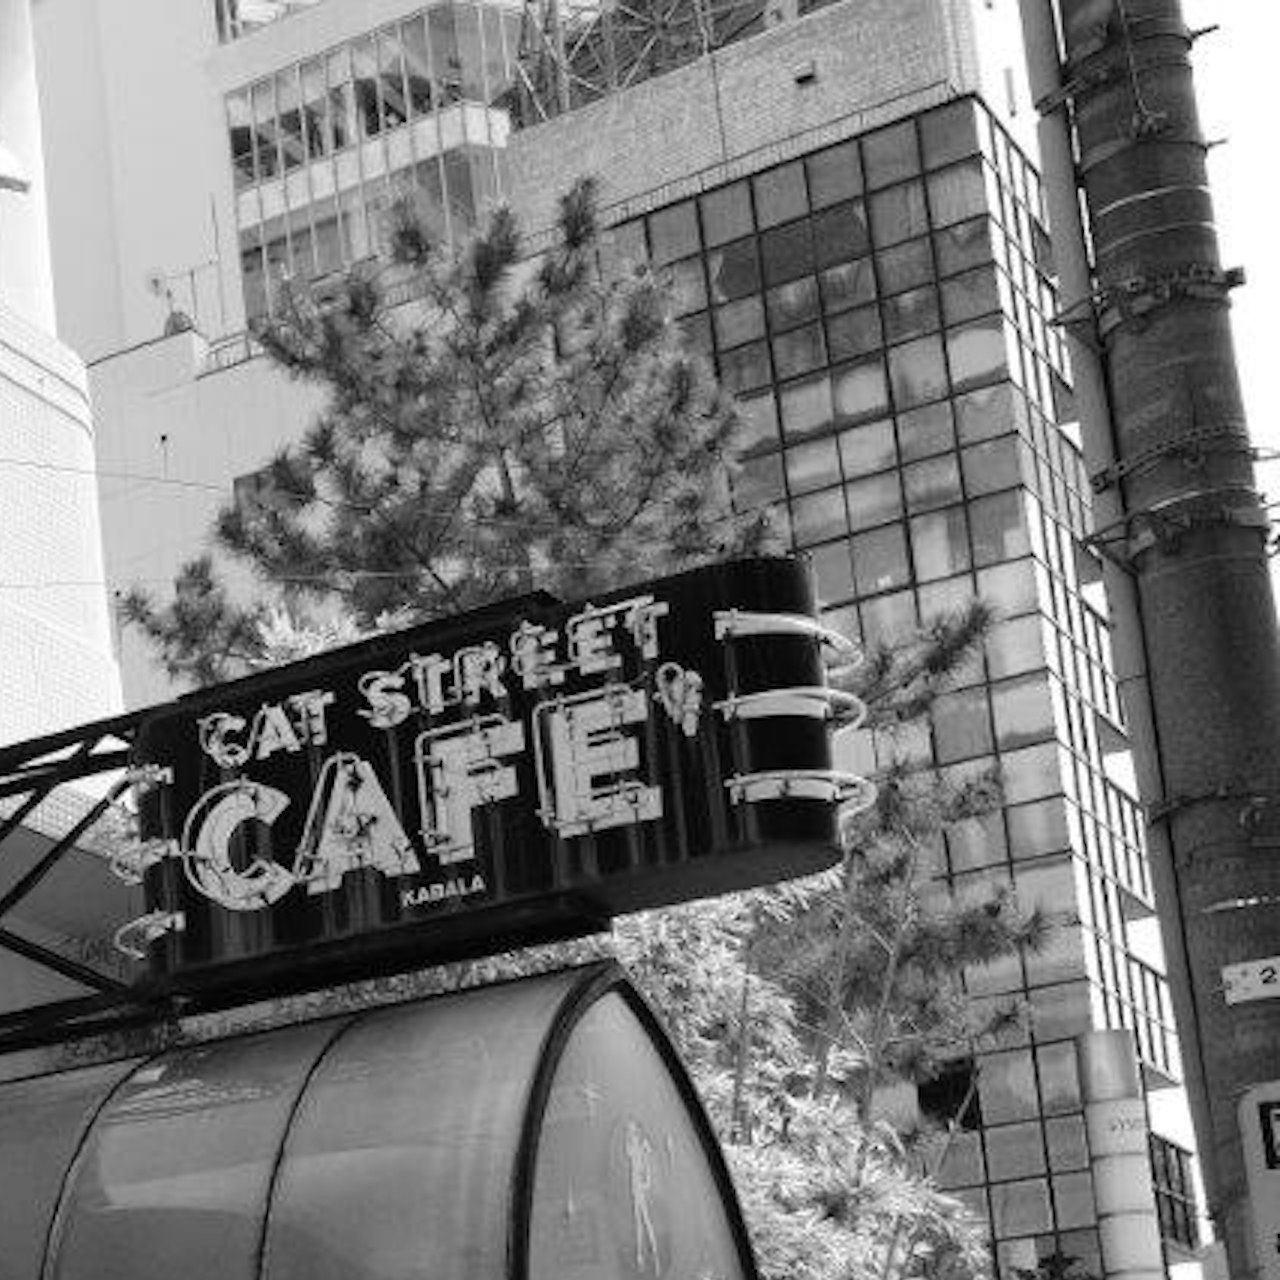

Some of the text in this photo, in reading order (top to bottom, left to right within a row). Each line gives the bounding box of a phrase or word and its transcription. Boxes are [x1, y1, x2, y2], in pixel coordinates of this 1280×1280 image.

[199, 595, 669, 767] CAT STREET
[400, 874, 486, 908] KABALA
